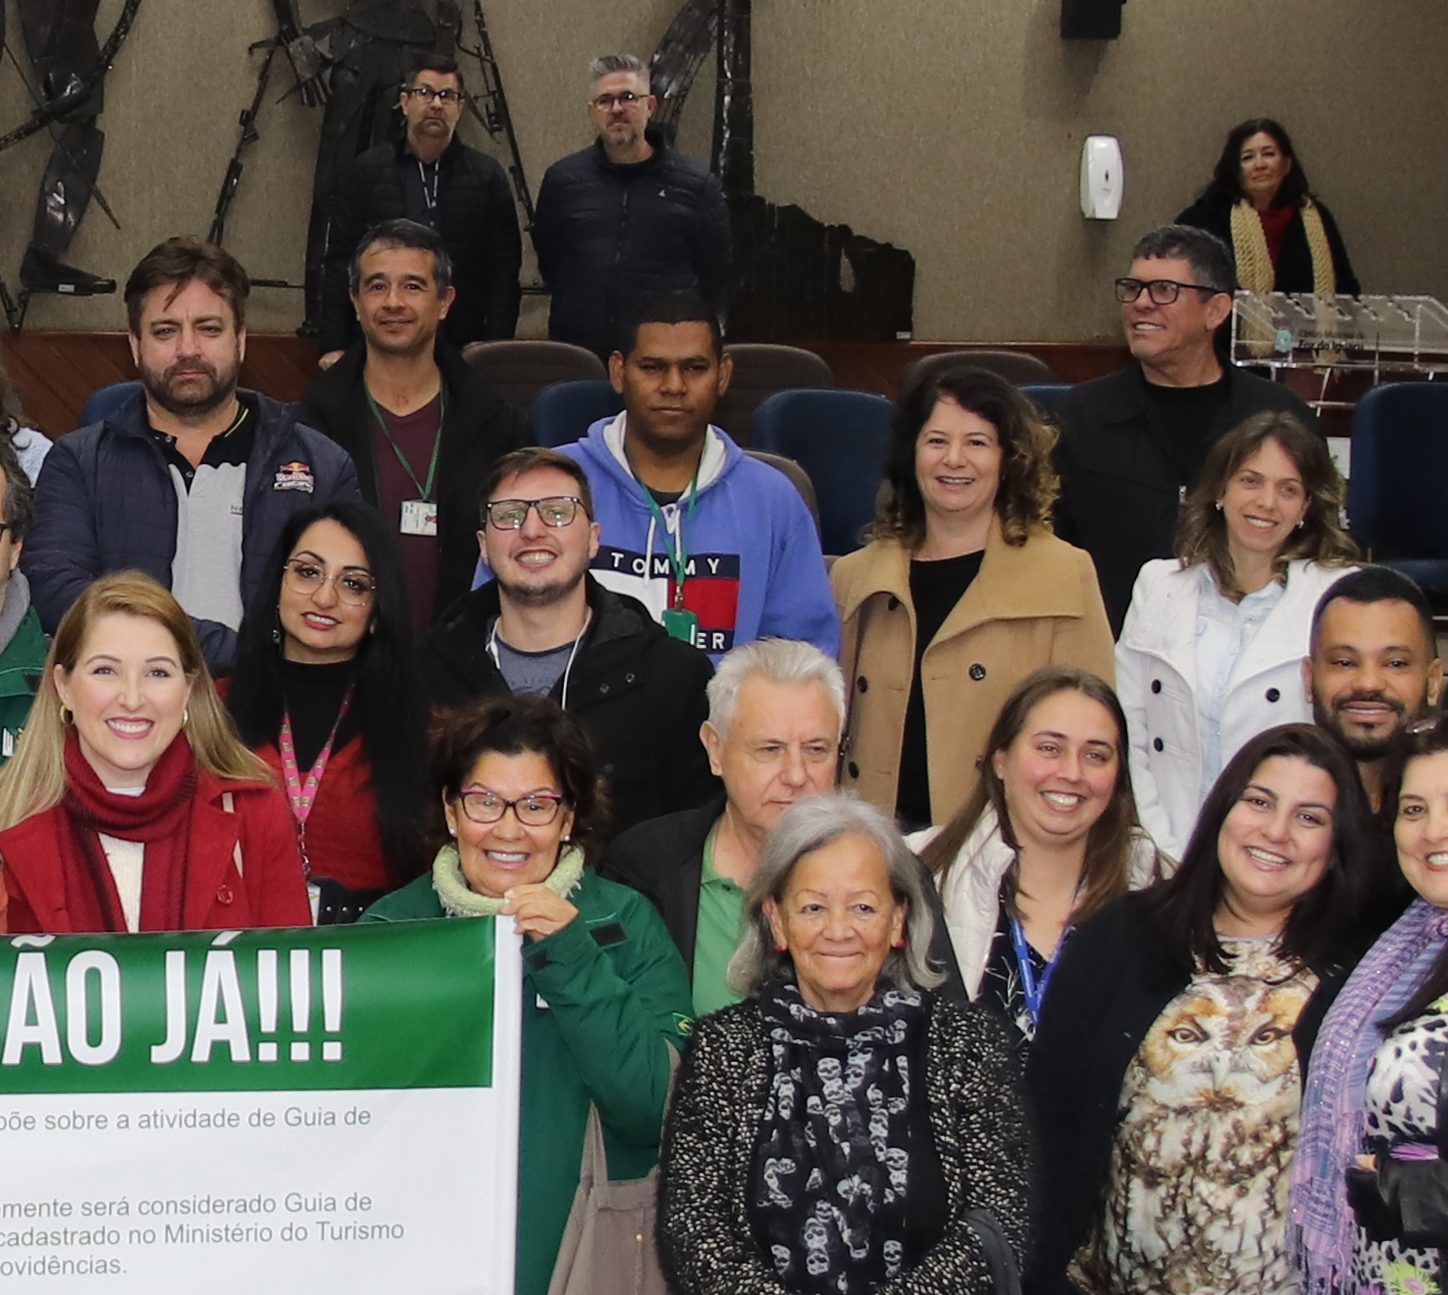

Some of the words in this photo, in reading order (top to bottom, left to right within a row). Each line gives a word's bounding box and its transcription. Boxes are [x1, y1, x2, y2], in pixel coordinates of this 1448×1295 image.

[611, 552, 720, 575] TOMMY
[149, 930, 345, 1064] JÁ!!!
[44, 1109, 109, 1131] sobre
[116, 1113, 130, 1130] a
[137, 1108, 241, 1130] atividade
[247, 1107, 276, 1128] de
[284, 1106, 336, 1127] Guia
[343, 1106, 372, 1126] de
[80, 1196, 130, 1217] será
[137, 1193, 277, 1216] considerado
[284, 1192, 337, 1213] Guia
[344, 1191, 373, 1212] de
[128, 1228, 157, 1245] no
[164, 1222, 273, 1244] Ministério
[280, 1221, 309, 1242] do
[315, 1220, 405, 1241] Turismo
